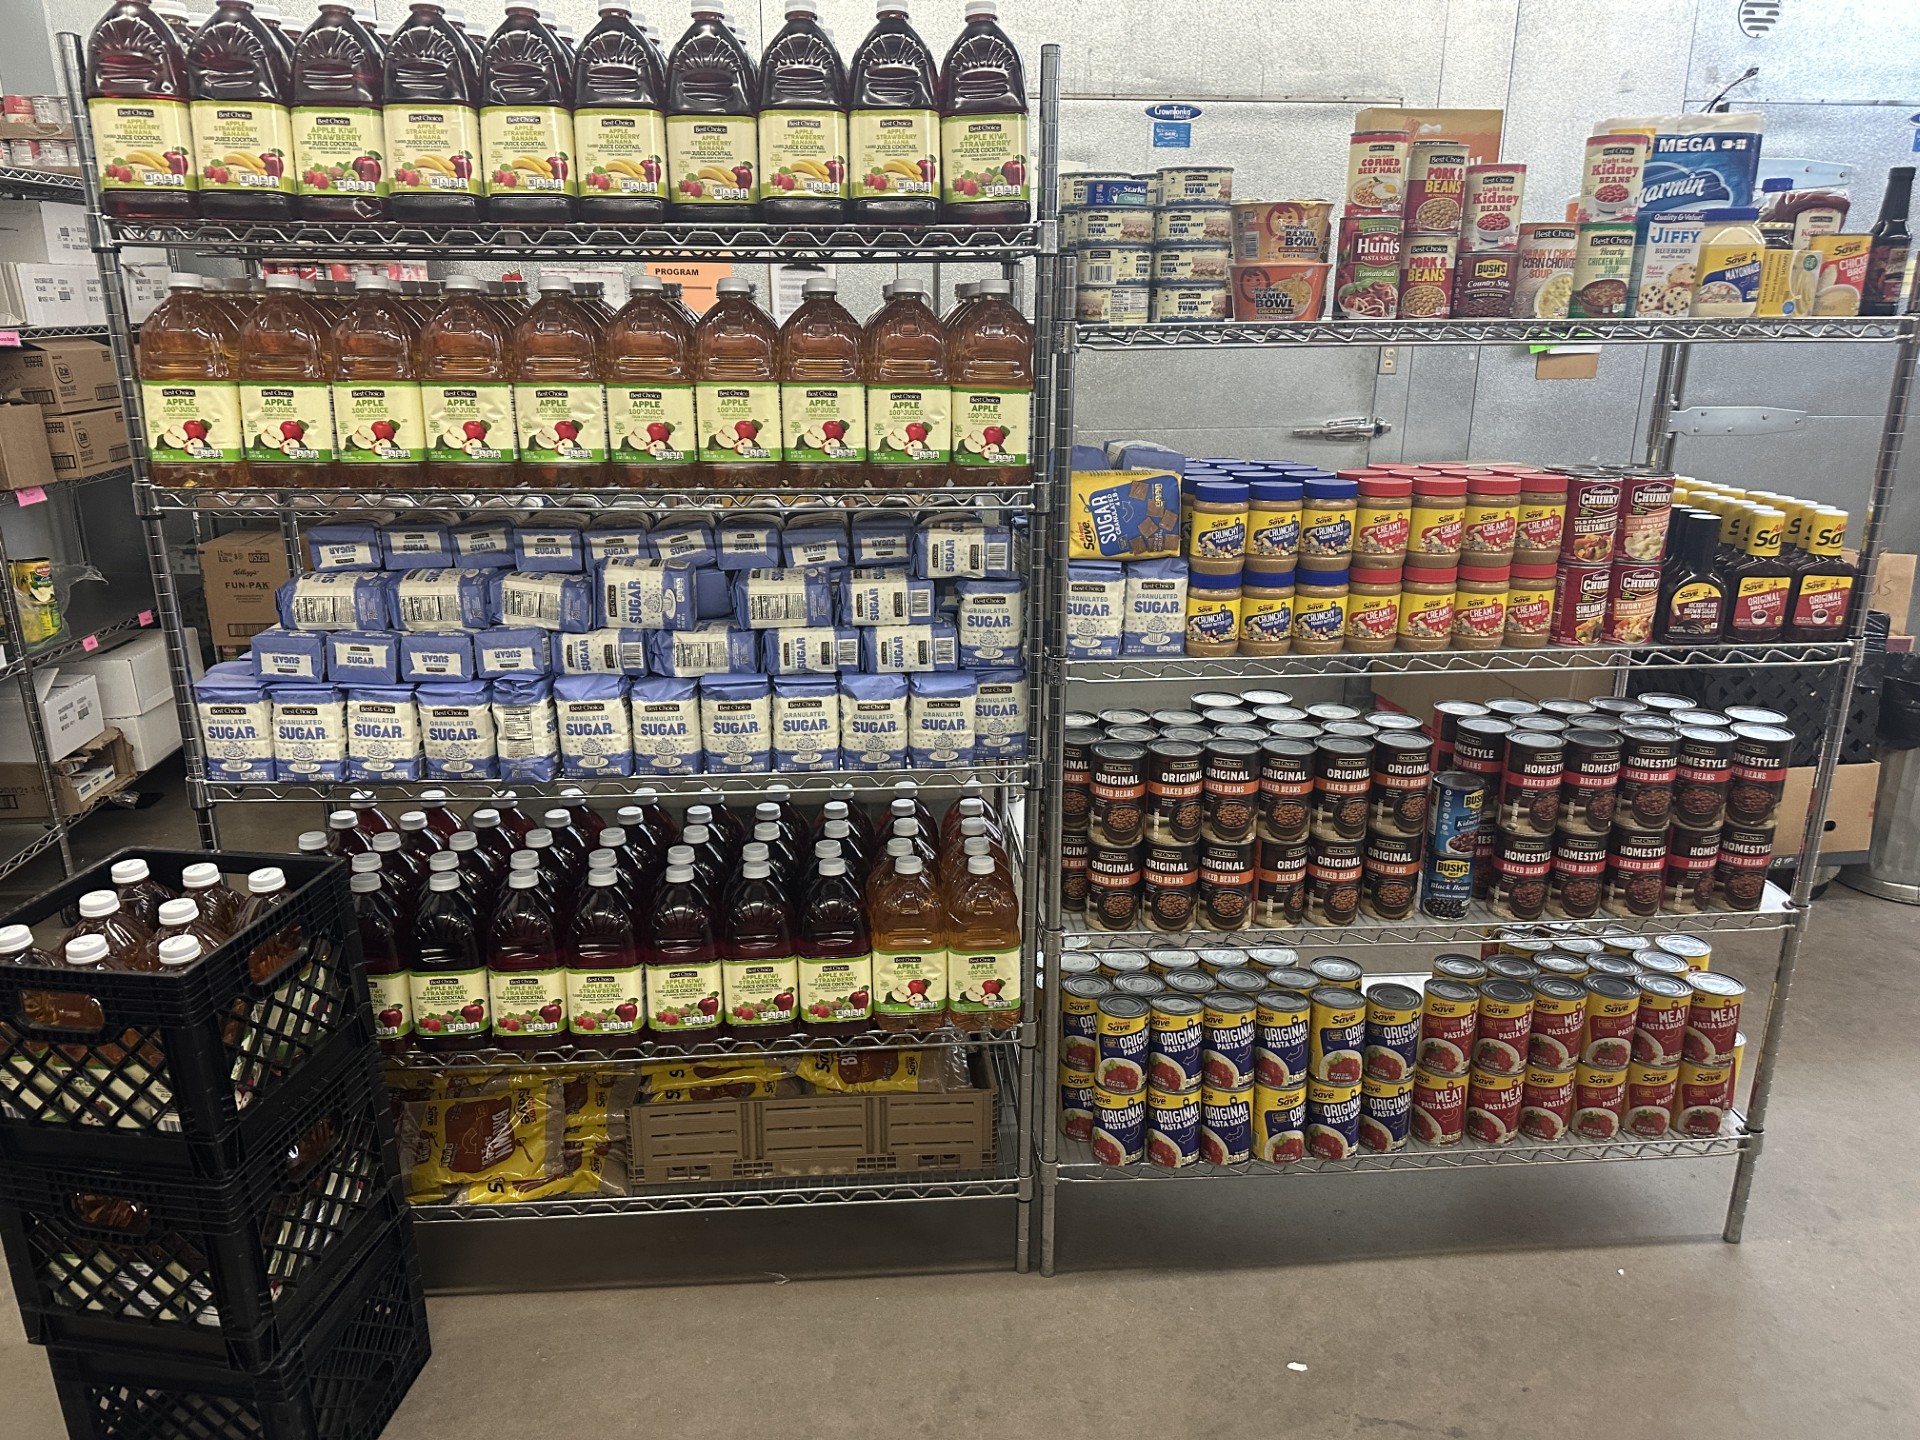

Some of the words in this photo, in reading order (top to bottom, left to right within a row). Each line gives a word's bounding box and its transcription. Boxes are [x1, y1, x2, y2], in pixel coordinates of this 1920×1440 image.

[1659, 138, 1716, 152] MEGA
[1380, 166, 1401, 174] HASH
[1427, 168, 1456, 180] PORK
[1458, 168, 1462, 178] &
[1425, 181, 1461, 193] BEANS
[1472, 193, 1519, 205] Kidney
[1654, 214, 1677, 222] Quality
[1536, 230, 1552, 238] Best
[1553, 230, 1575, 238] Choice
[1650, 227, 1702, 243] JIFFY
[1285, 237, 1318, 246] BOWL
[1357, 238, 1400, 254] Hunt's
[1600, 248, 1624, 256] Hearty
[1833, 243, 1860, 256] Save
[1522, 258, 1547, 268] CORN
[1725, 255, 1747, 266] Save
[1477, 264, 1506, 274] BUSH'S
[1529, 269, 1552, 278] SOUP
[1725, 262, 1760, 280] MAYONNAISE
[1467, 280, 1495, 288] Country
[1256, 299, 1294, 308] BOWL
[972, 404, 998, 412] APPLE
[1581, 494, 1619, 504] CHUNKY
[1634, 492, 1670, 503] CHUNKY
[1091, 496, 1116, 545] SUGAR
[1483, 520, 1509, 531] CREAMY
[1315, 523, 1344, 536] CRUNCHY
[1376, 522, 1402, 535] CREAMY
[1575, 522, 1609, 532] VEGETABLE
[1084, 524, 1095, 550] Save
[1212, 526, 1239, 540] CRUNCHY
[1623, 578, 1659, 588] CHUNKY
[1743, 583, 1763, 592] Save
[628, 581, 642, 624] SUGAR
[1748, 592, 1780, 606] ORIGINAL
[1809, 592, 1842, 605] ORIGINAL
[1134, 602, 1179, 613] SUGAR
[1764, 601, 1780, 609] SAUCE
[1365, 608, 1390, 620] CREAMY
[967, 615, 1011, 627] SUGAR
[346, 656, 374, 664] SUGAR
[713, 722, 758, 734] SUGAR
[921, 718, 965, 730] SUGAR
[208, 726, 256, 739] SUGAR
[430, 728, 478, 741] SUGAR
[1628, 757, 1677, 768] HOMESTYLE
[1096, 773, 1139, 784] ORIGINAL
[1327, 769, 1370, 779] ORIGINAL
[1626, 770, 1648, 779] BAKED
[1649, 772, 1669, 780] BEANS
[1096, 787, 1113, 797] BAKED
[1114, 789, 1134, 797] BEANS
[1723, 842, 1772, 853] HOMESTYLE
[1504, 850, 1551, 862] HOMESTYLE
[1092, 861, 1134, 873] ORIGINAL
[1438, 863, 1469, 872] BUSH'S
[1332, 1016, 1355, 1024] Save
[1659, 1009, 1686, 1023] MEAT
[1107, 1023, 1130, 1031] Save
[1666, 1021, 1684, 1029] SAUCE
[1213, 1023, 1255, 1043] ORIGINAL
[1217, 1041, 1239, 1051] PASTA
[1435, 1088, 1462, 1103] MEAT
[1422, 1101, 1441, 1110] PASTA
[1442, 1101, 1462, 1109] SAUCE
[1205, 1104, 1249, 1119] ORIGINAL
[1208, 1119, 1229, 1127] PASTA
[1230, 1114, 1249, 1126] SAUCE
